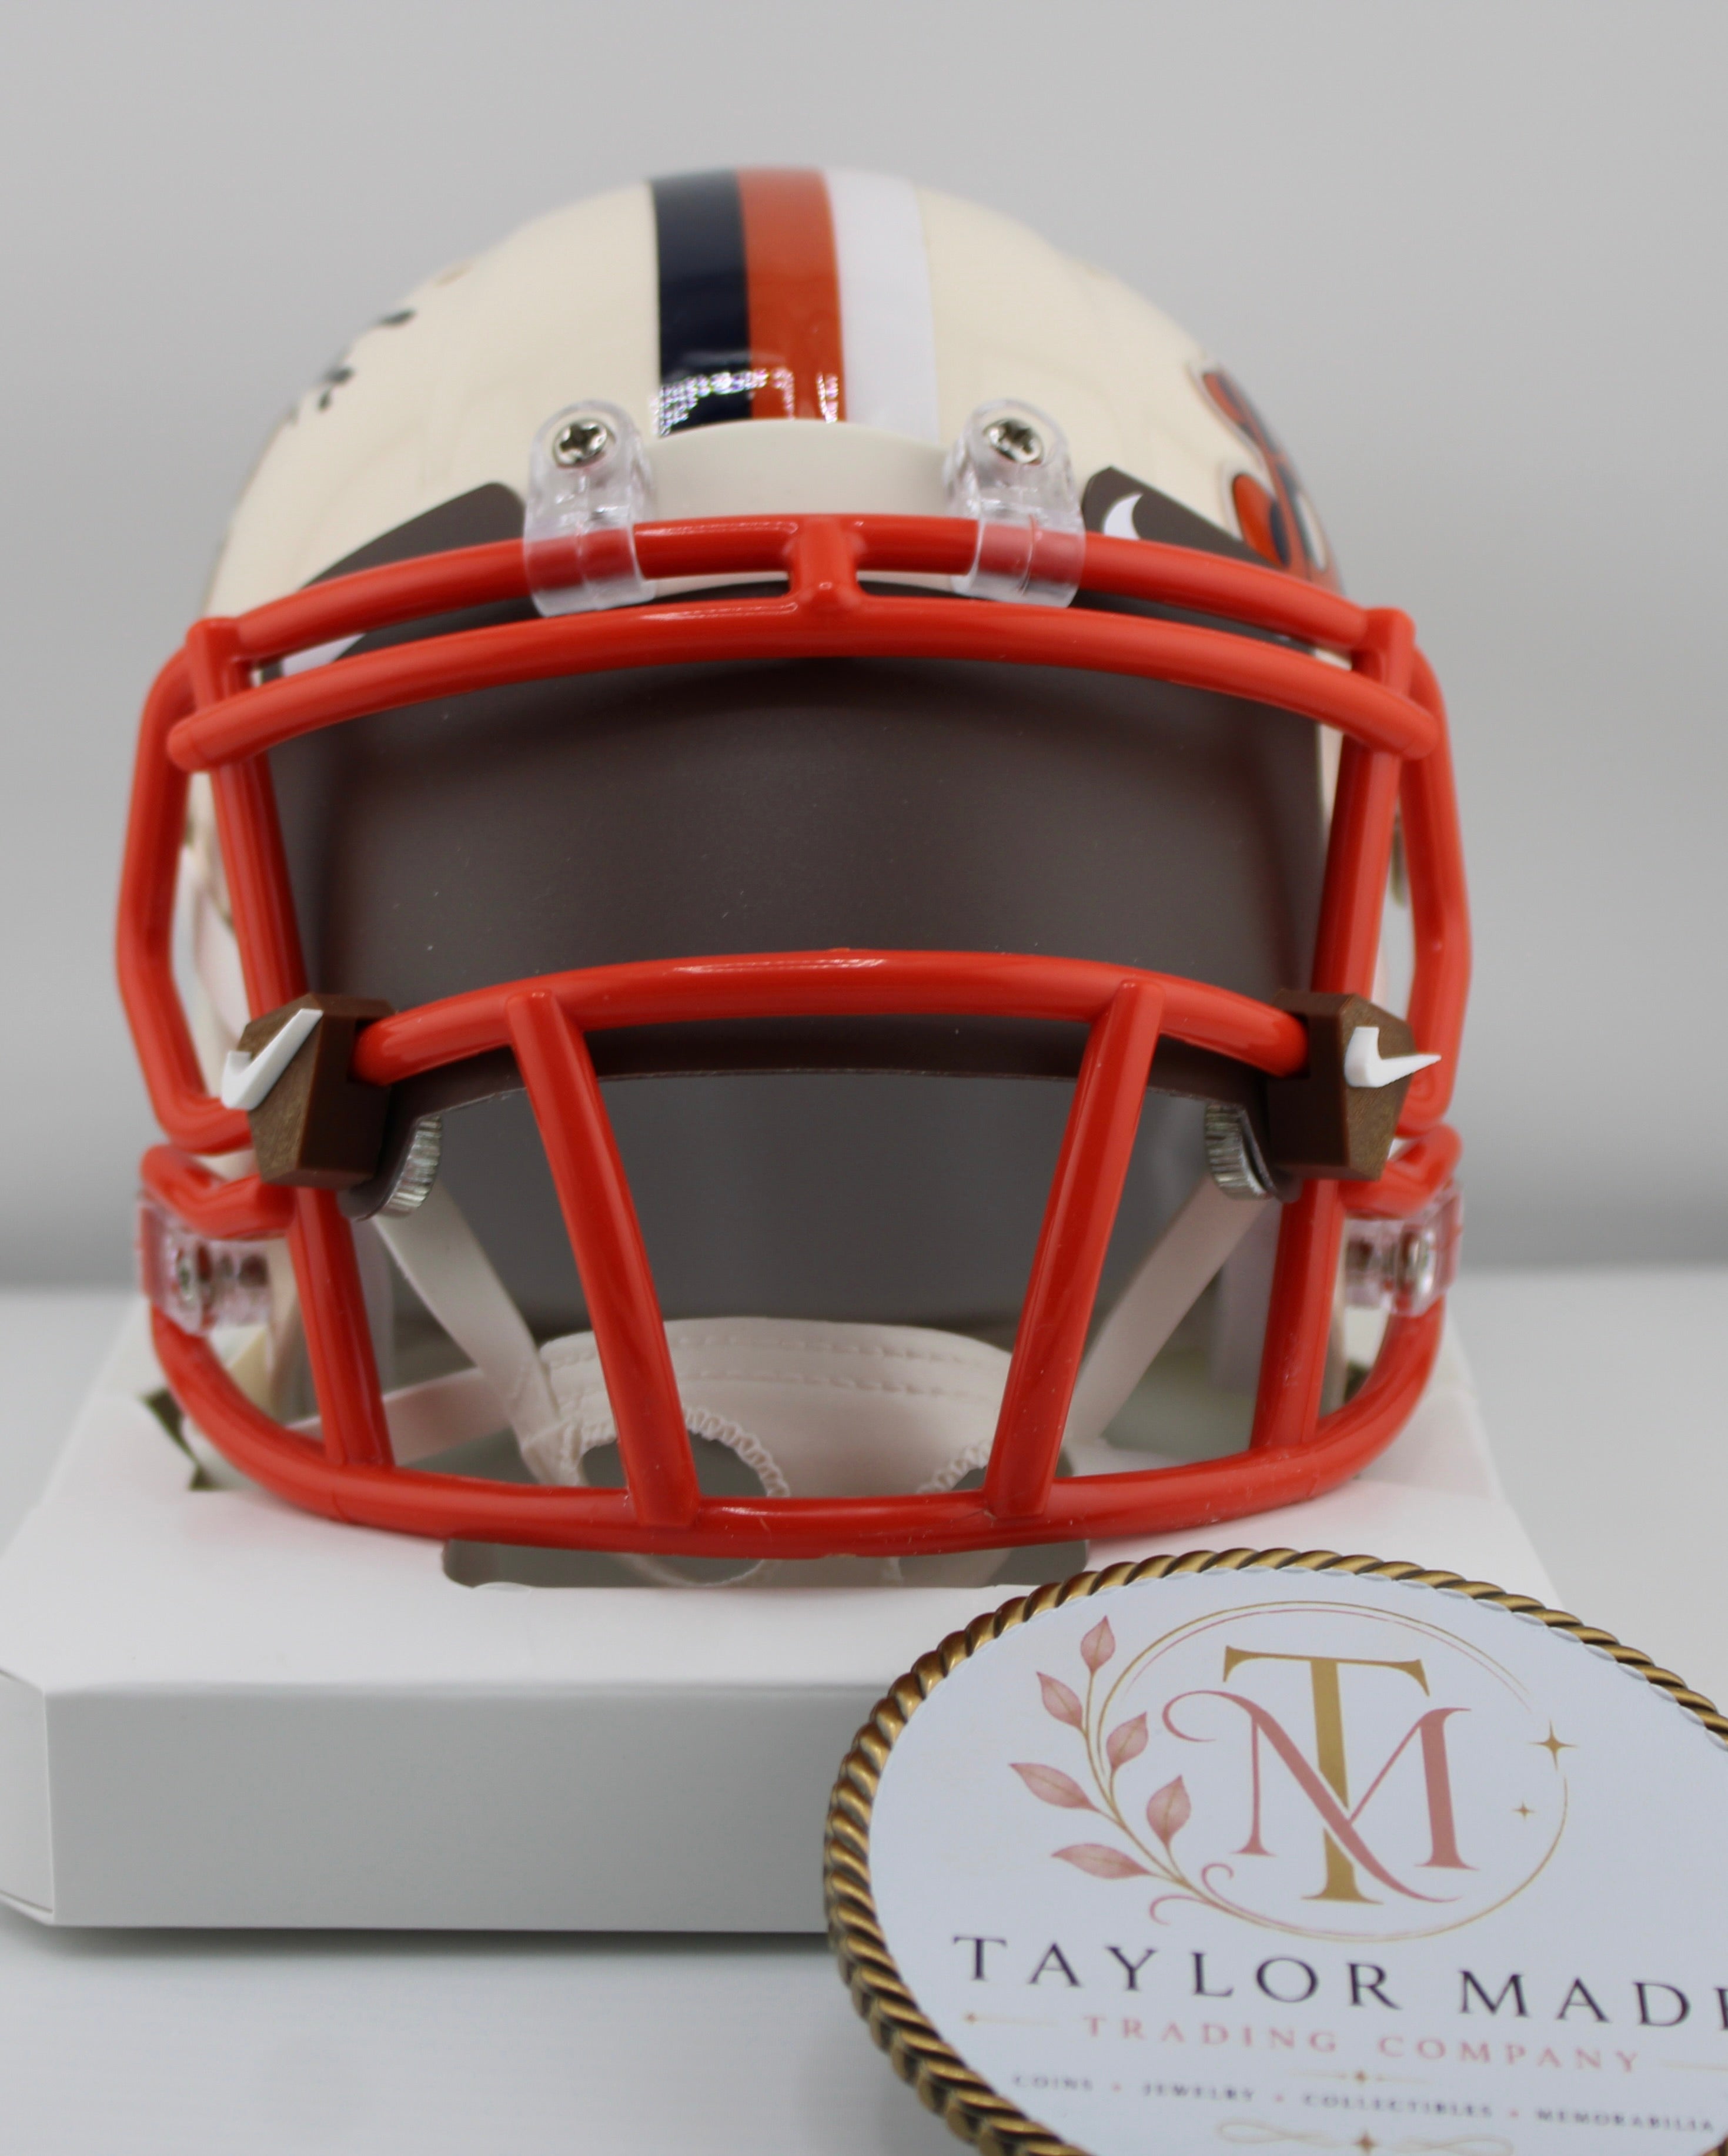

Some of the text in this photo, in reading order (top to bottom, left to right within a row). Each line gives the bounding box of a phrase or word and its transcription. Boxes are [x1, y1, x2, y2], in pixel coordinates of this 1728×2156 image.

[953, 1936, 1402, 2010] TAYLOR
[1084, 2016, 1639, 2072] TRADING COMPANY
[1013, 2074, 1094, 2091] COINS
[1142, 2082, 1255, 2101] JEWELRY
[1302, 2093, 1493, 2117] COLLECTIBLES
